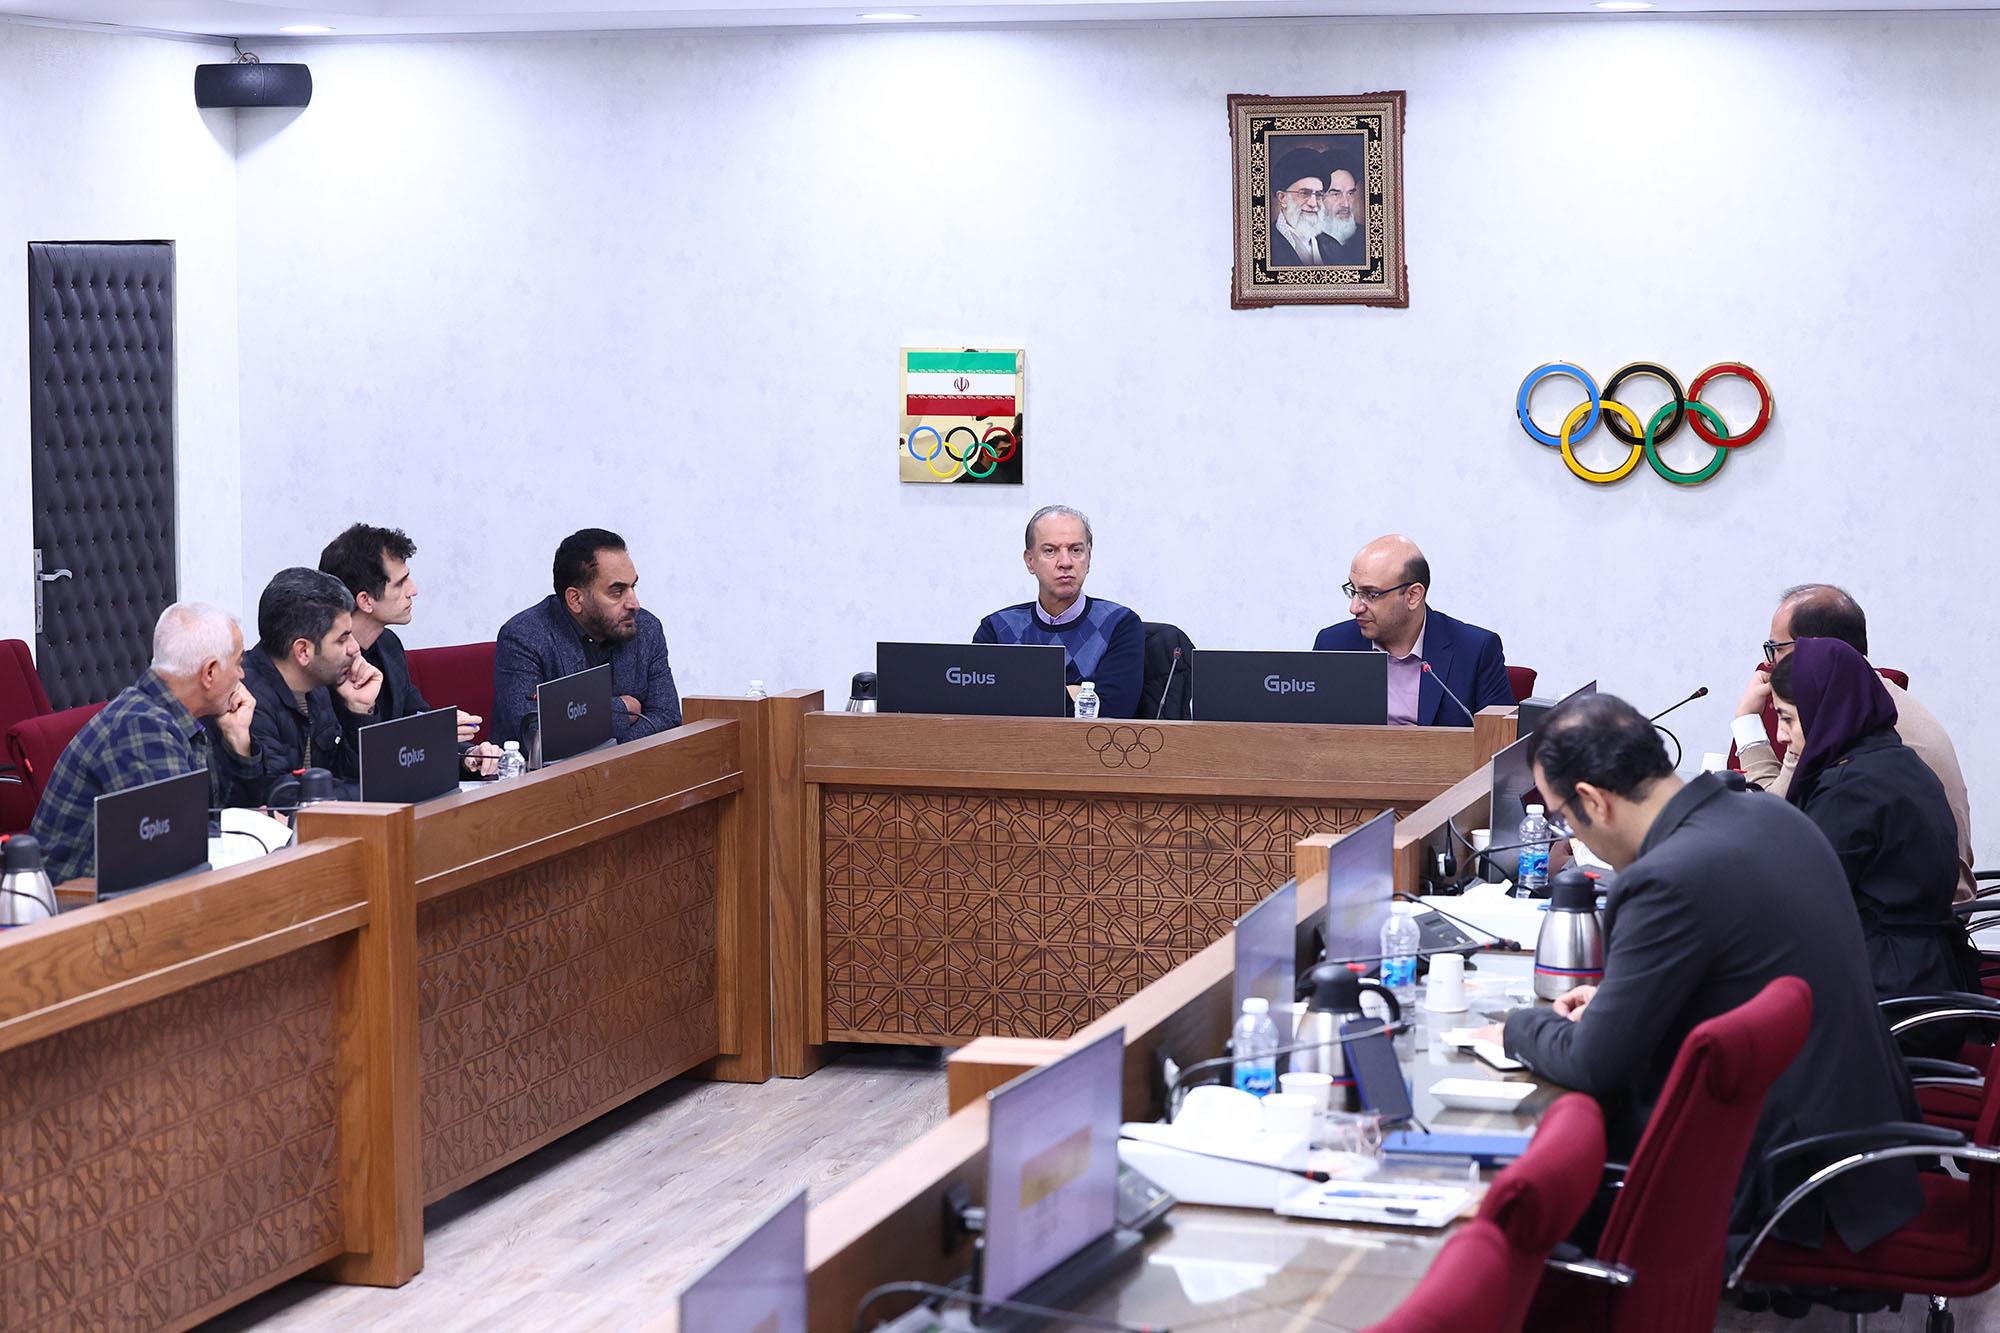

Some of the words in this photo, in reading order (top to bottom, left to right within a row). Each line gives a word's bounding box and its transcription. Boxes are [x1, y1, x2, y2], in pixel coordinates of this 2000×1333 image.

[946, 667, 996, 686] Gplus
[1264, 675, 1316, 694] Gplus
[567, 701, 587, 720] Gplus
[399, 746, 425, 768] Gplus
[140, 817, 170, 841] Gplus
